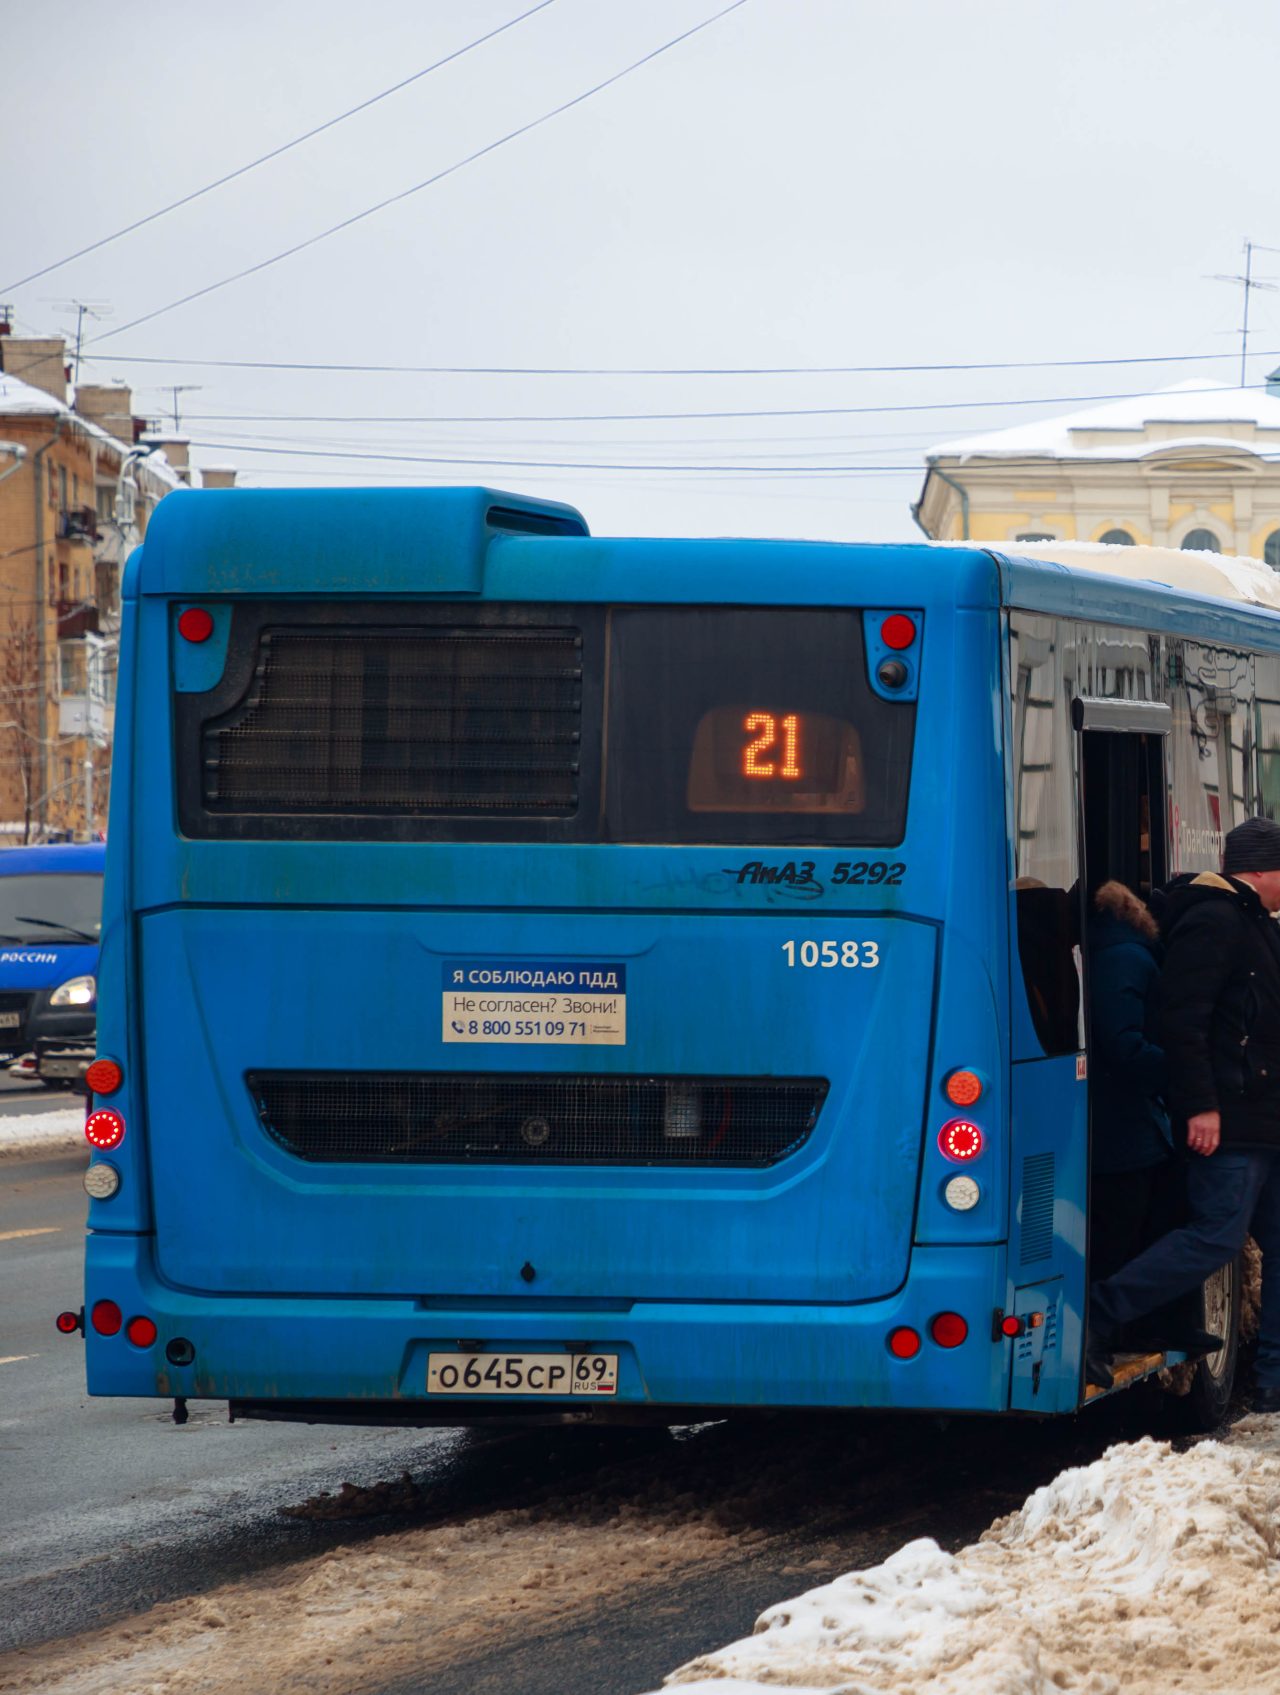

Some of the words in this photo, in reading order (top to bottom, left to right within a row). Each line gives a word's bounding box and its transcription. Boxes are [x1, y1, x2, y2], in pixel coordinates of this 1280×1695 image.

[746, 713, 800, 777] 21
[830, 861, 906, 885] 5292
[0, 952, 57, 964] РОССИИ
[782, 940, 880, 968] 10583
[453, 970, 464, 983] Я
[468, 970, 575, 987] СОБЛЮДАЮ
[579, 972, 618, 989] ПДД
[453, 997, 476, 1012] Не
[479, 998, 557, 1013] согласен?
[562, 998, 617, 1014] Звони!
[468, 1020, 478, 1035] 8
[482, 1020, 511, 1035] 800
[514, 1021, 540, 1036] 551
[544, 1021, 565, 1036] 09
[569, 1022, 586, 1036] 71
[575, 1356, 607, 1381] 69
[574, 1382, 597, 1391] RUS
